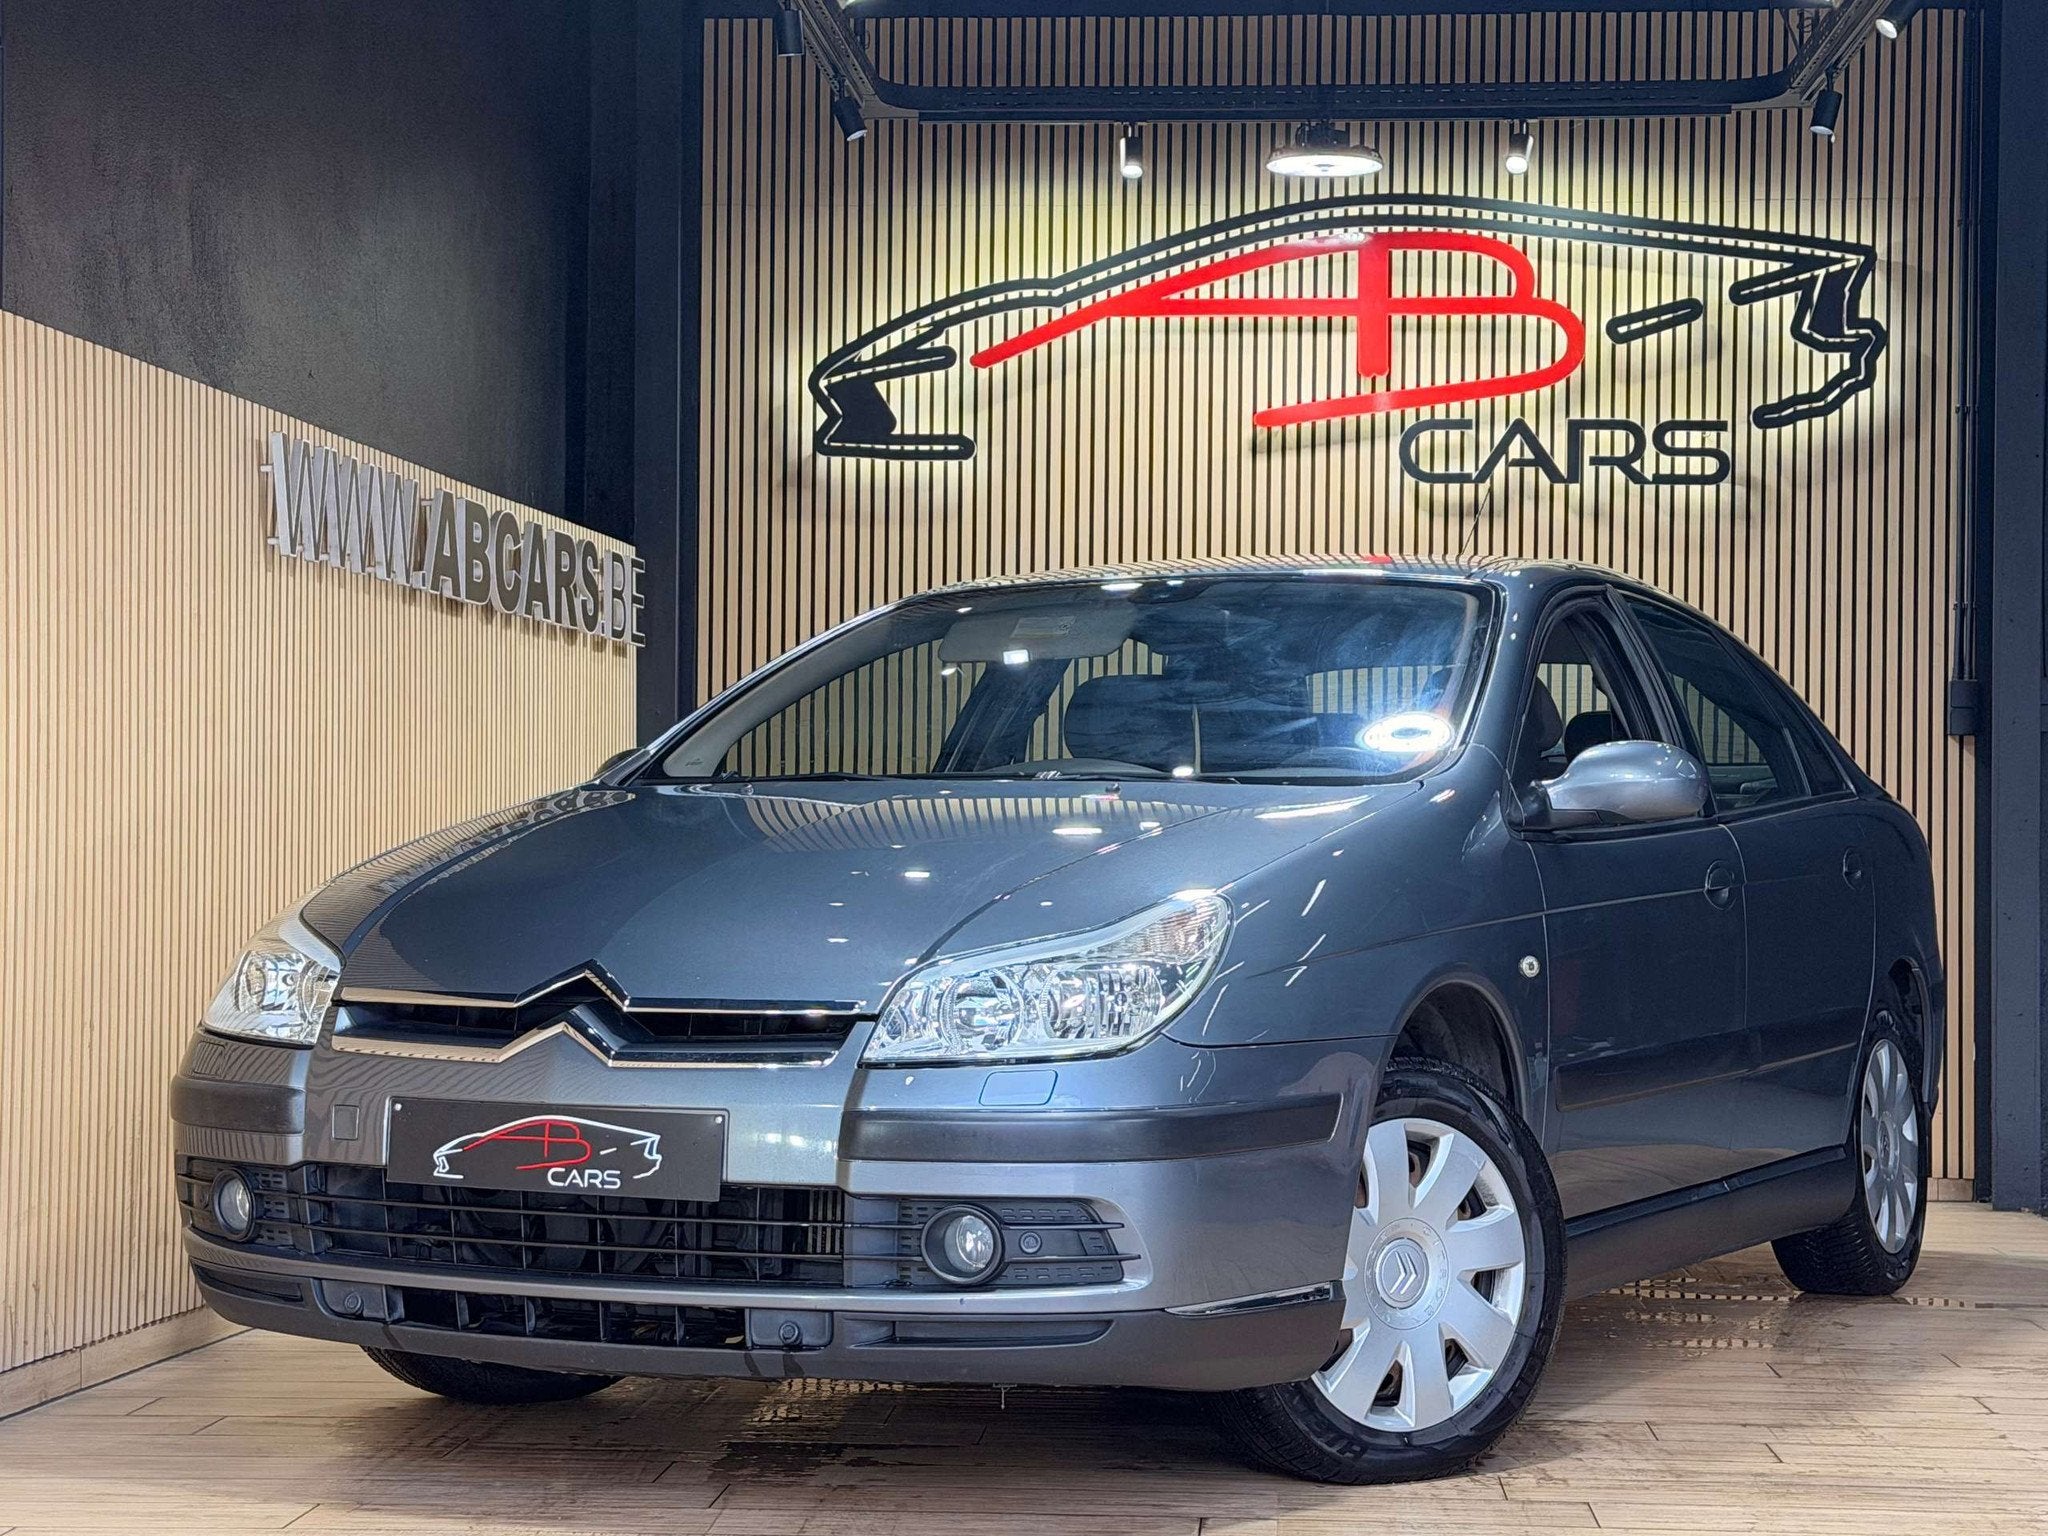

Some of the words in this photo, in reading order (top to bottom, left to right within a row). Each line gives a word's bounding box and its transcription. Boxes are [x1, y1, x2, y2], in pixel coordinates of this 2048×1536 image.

[1399, 418, 1731, 485] CARS
[271, 431, 646, 647] WWW.ABCARS.BE
[547, 1167, 621, 1190] CARS
